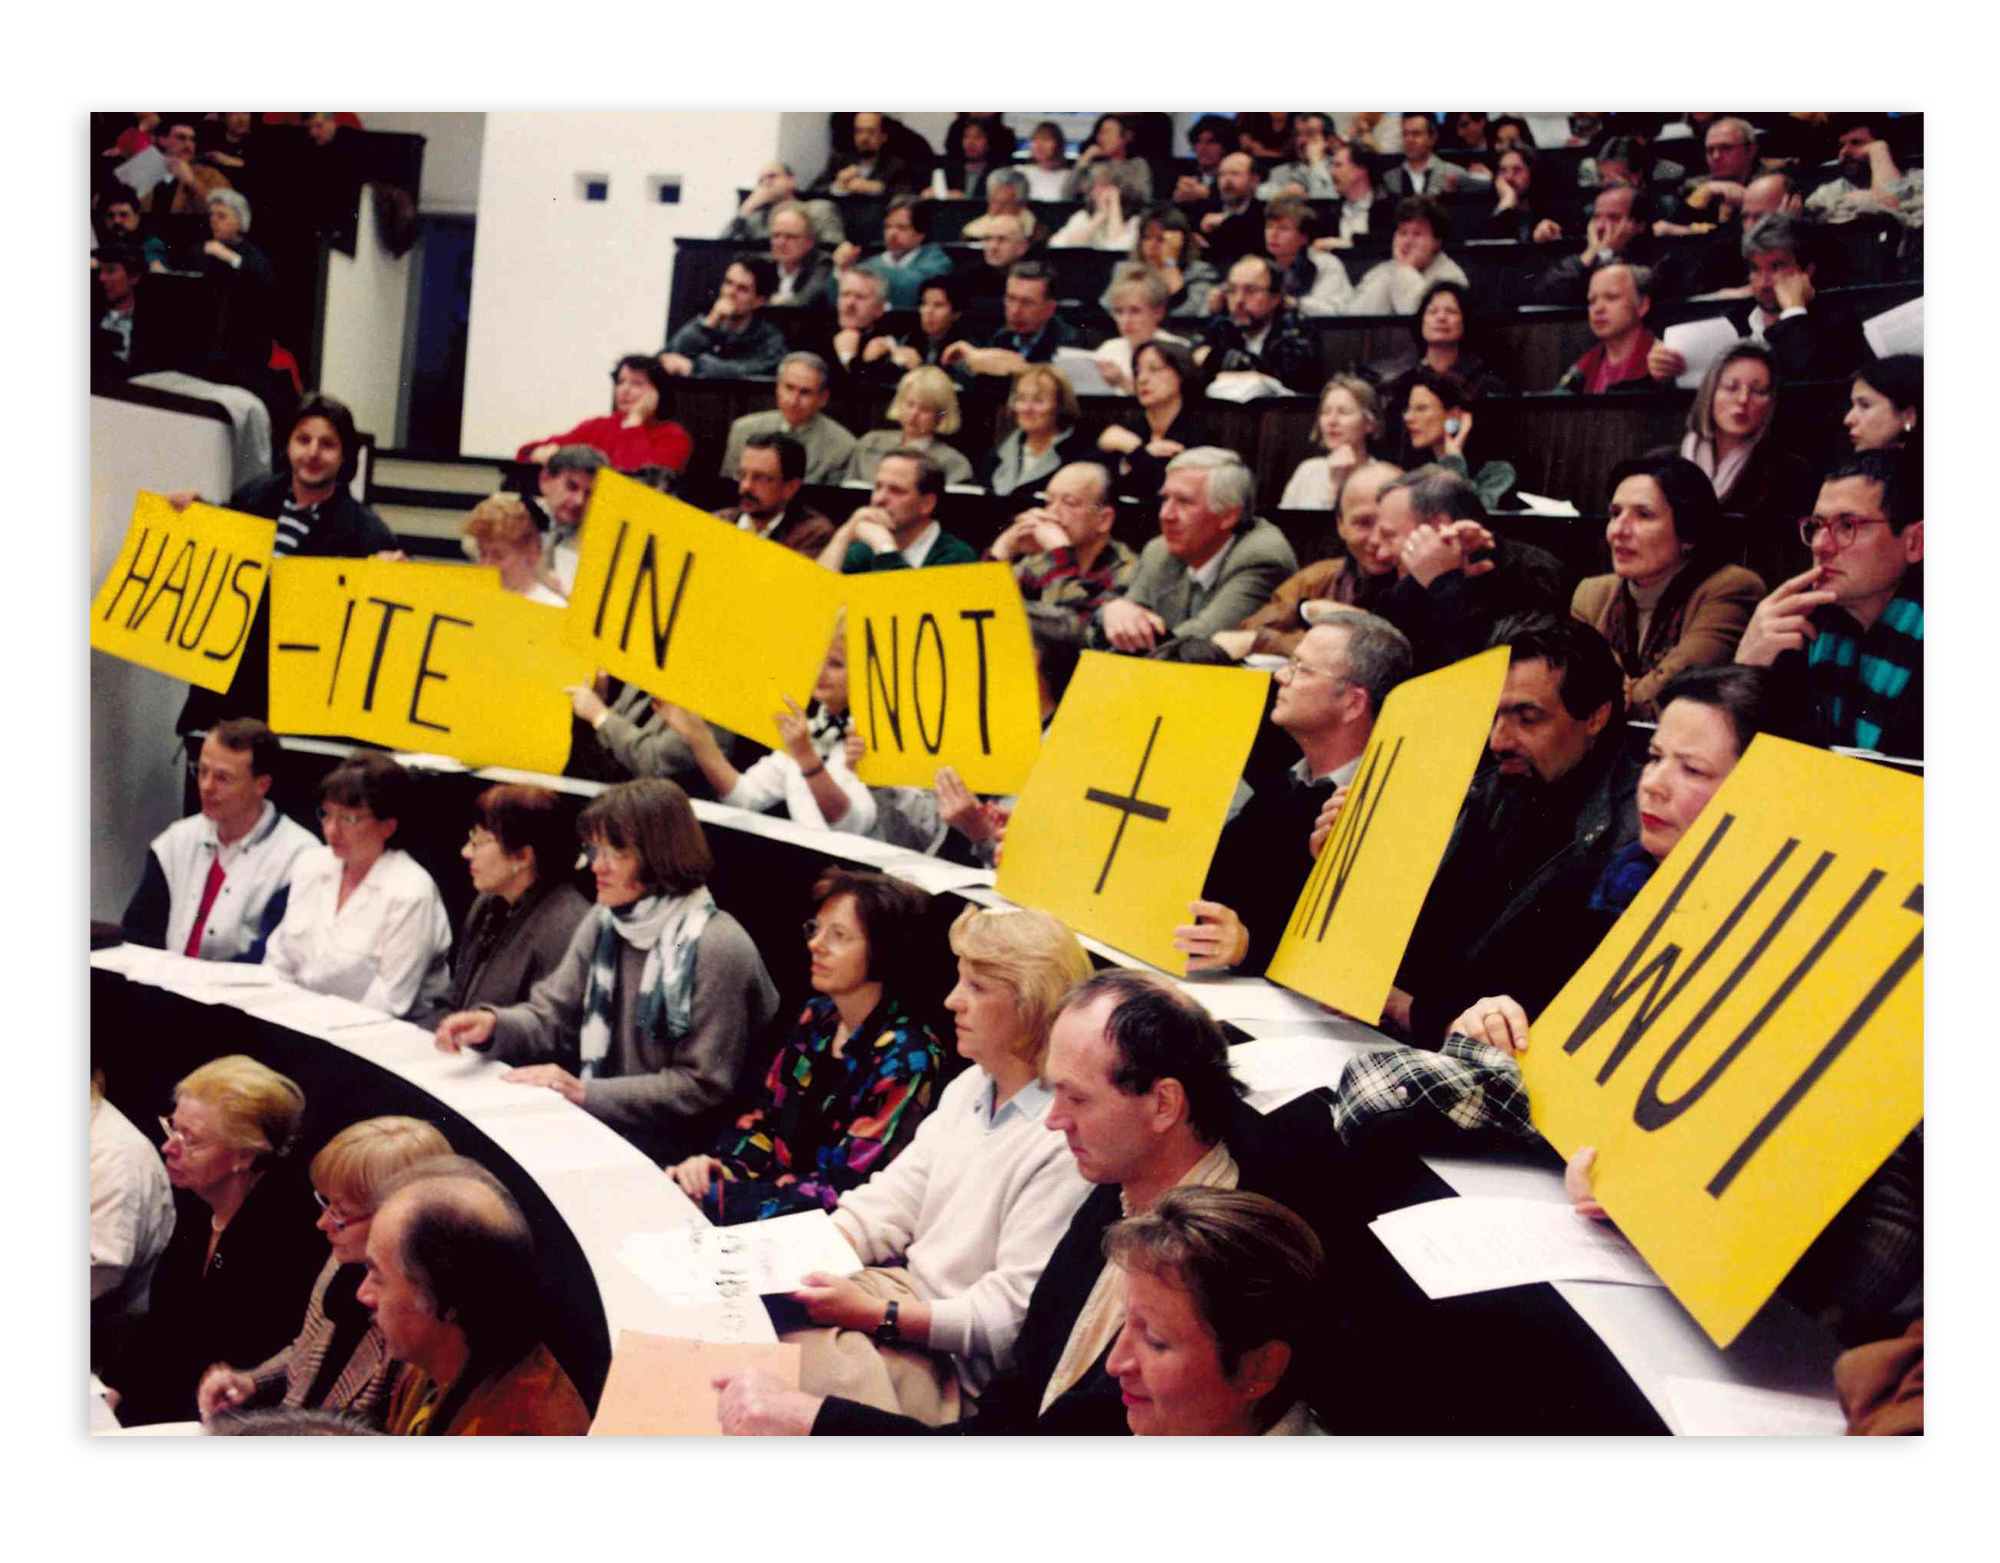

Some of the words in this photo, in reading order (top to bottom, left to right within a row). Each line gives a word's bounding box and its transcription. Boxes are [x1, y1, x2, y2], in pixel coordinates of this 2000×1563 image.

[104, 528, 262, 661] HAUS
[594, 522, 695, 669] IN
[864, 610, 996, 755] NOT
